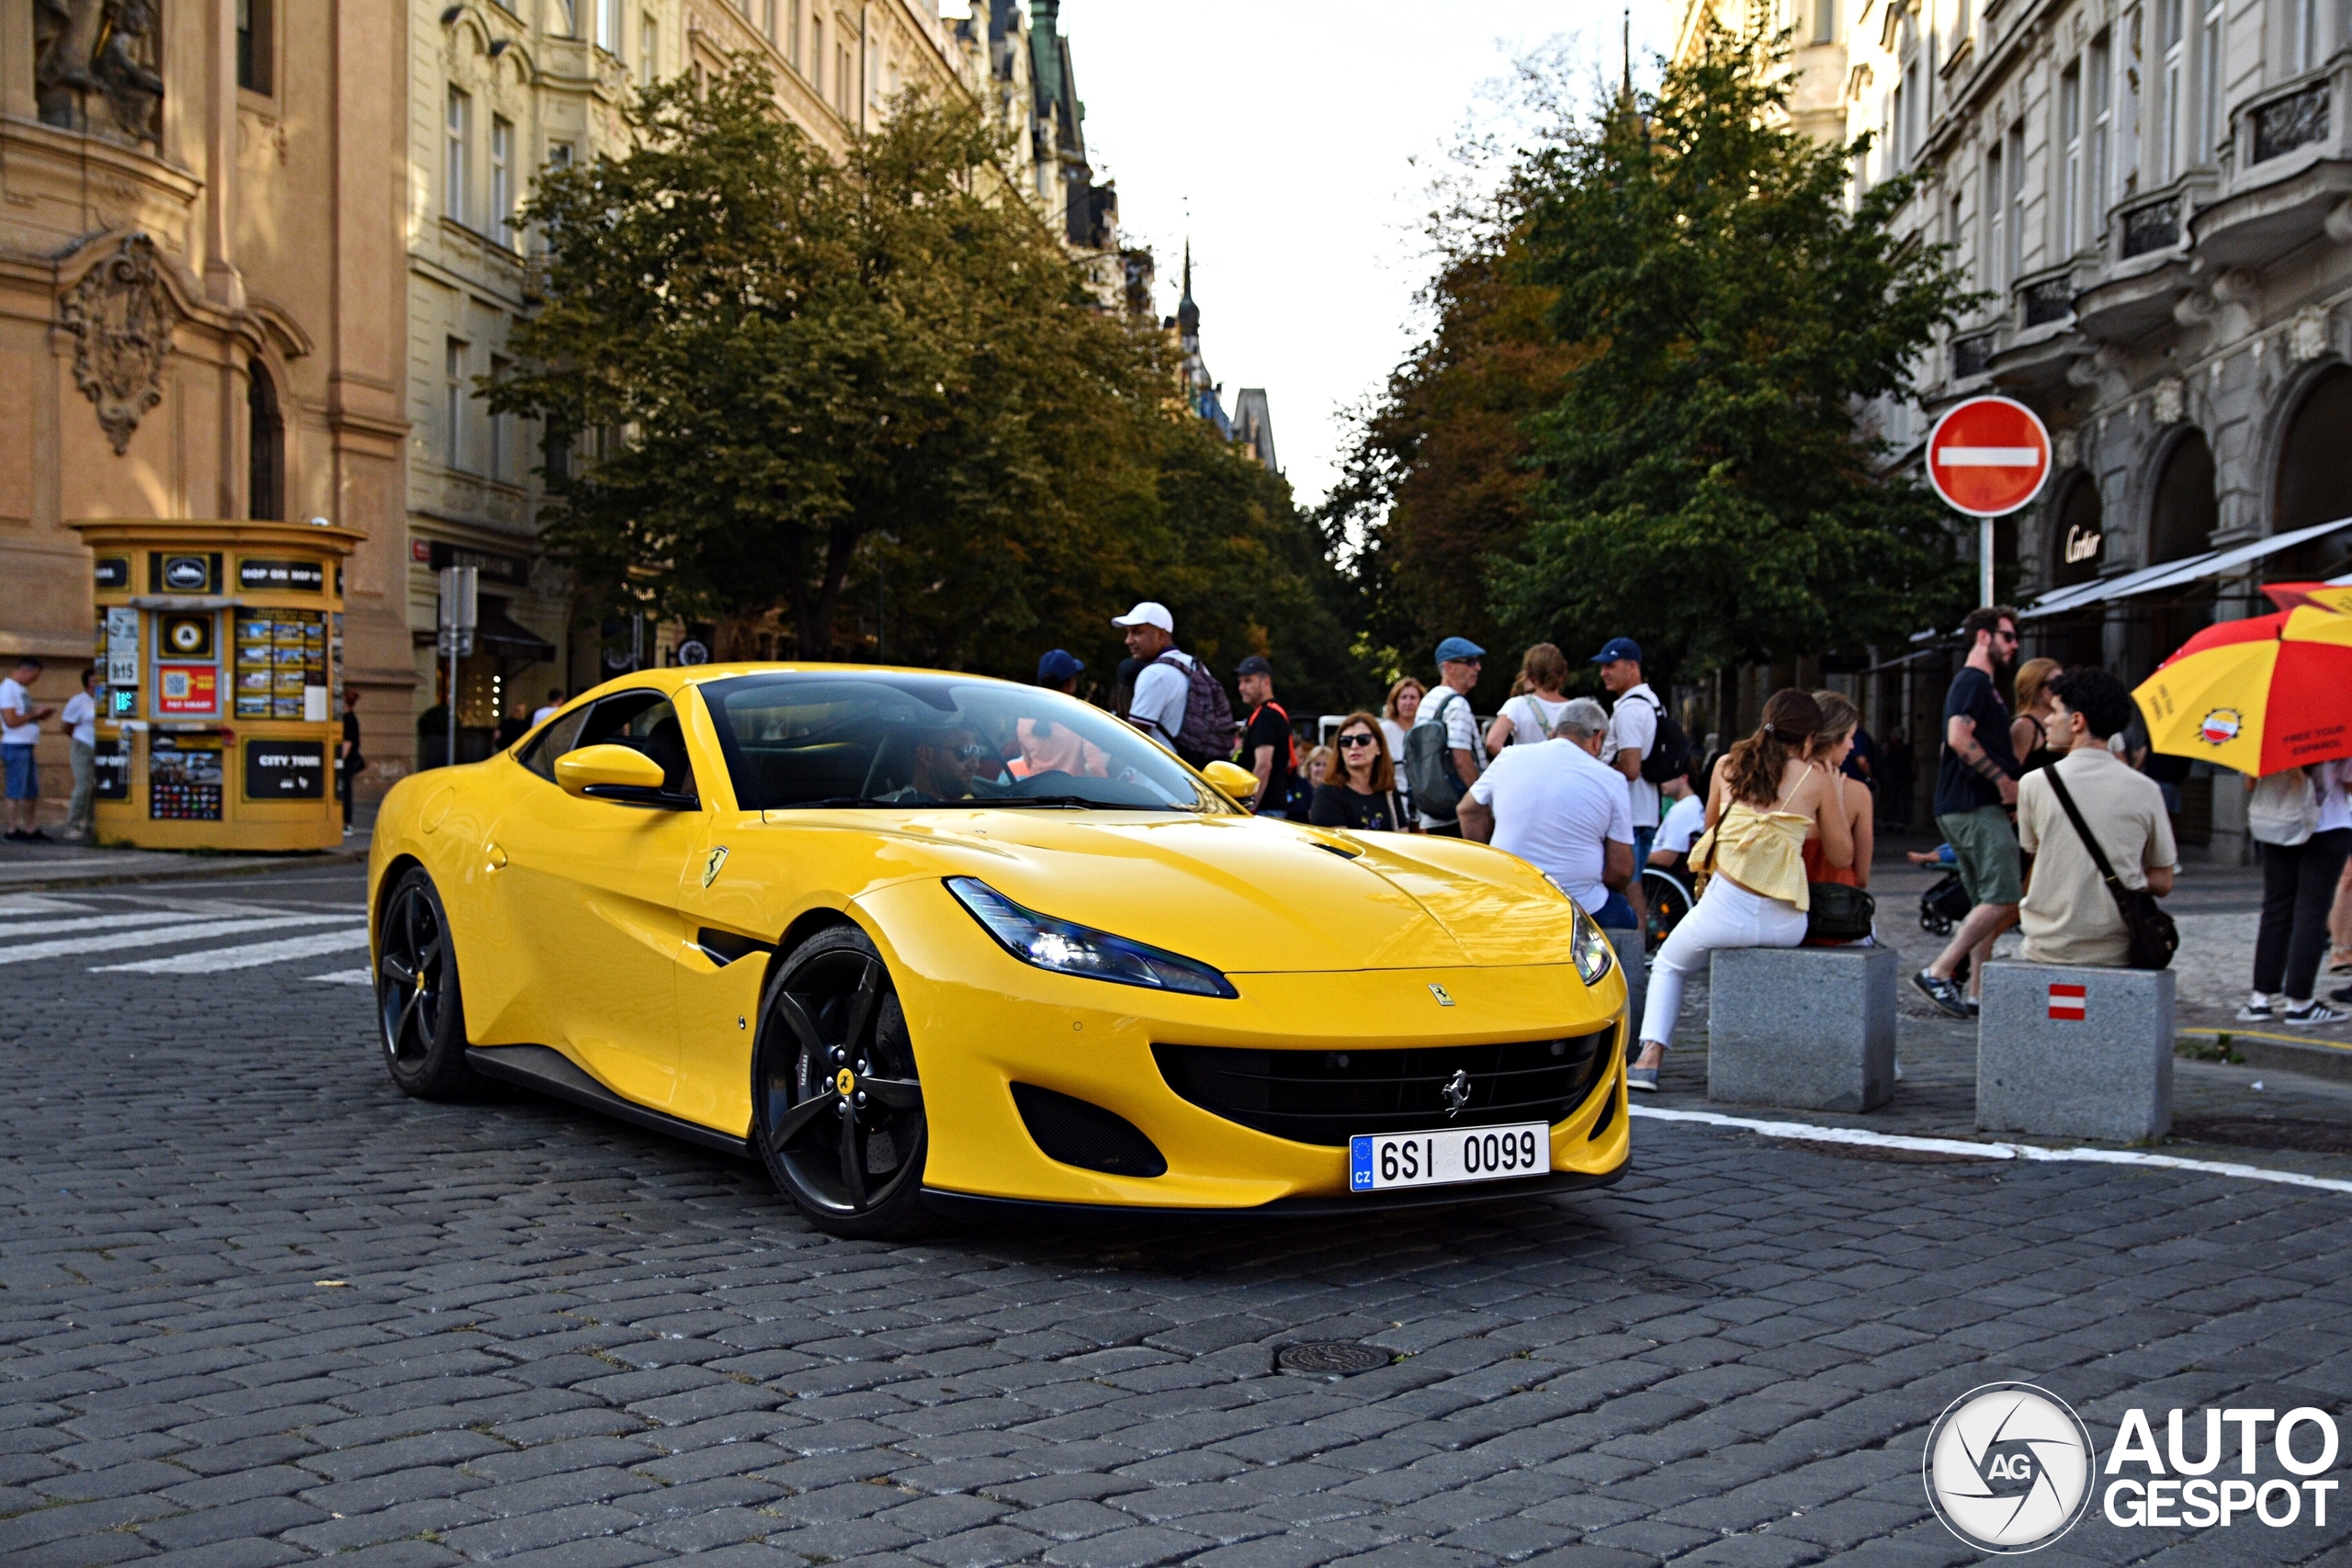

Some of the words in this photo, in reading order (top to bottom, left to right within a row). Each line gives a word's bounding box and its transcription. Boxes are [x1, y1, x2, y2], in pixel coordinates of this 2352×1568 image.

[2064, 524, 2101, 564] Cartier
[242, 568, 268, 580] HOP
[269, 569, 289, 581] ON
[2282, 731, 2311, 743] FREE
[2314, 723, 2346, 737] TOUR
[258, 754, 289, 768] CITY
[1464, 1130, 1535, 1173] 0099
[1355, 1170, 1371, 1184] CZ
